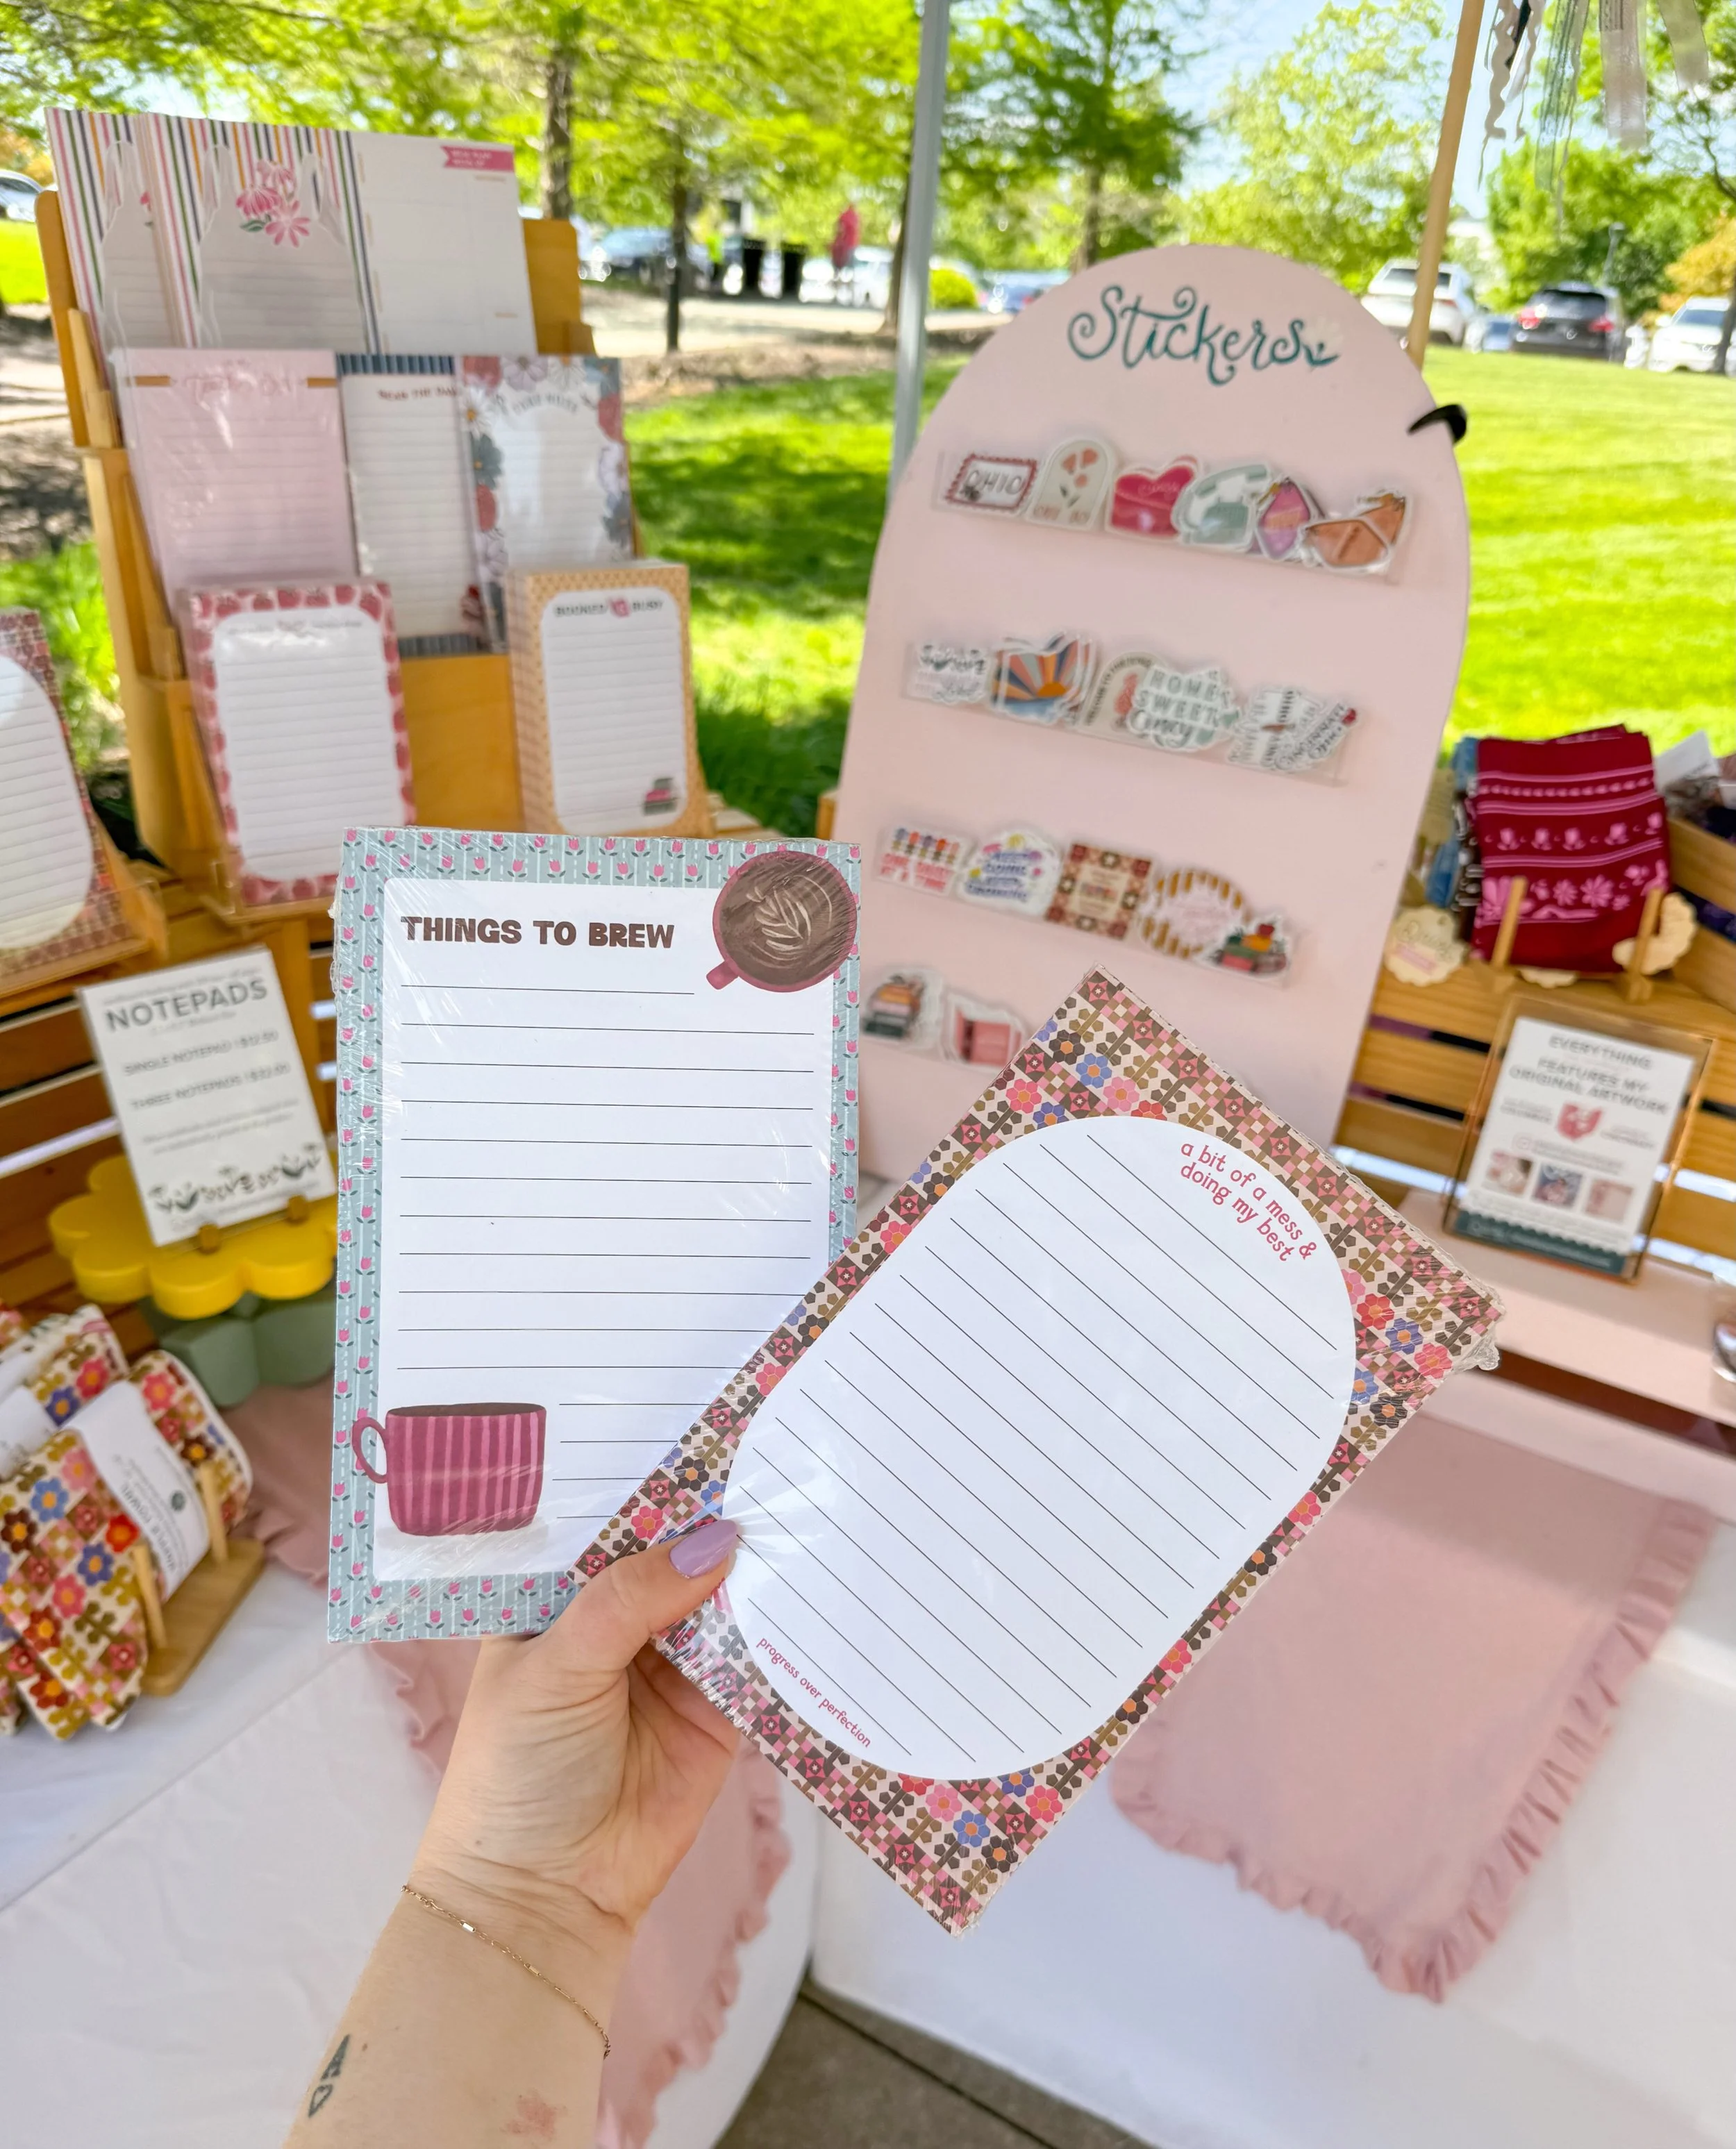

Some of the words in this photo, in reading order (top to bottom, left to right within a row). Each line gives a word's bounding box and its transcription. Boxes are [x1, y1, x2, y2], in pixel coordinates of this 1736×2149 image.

[1067, 285, 1303, 385] Stickers
[965, 469, 1022, 495] OHIO
[1151, 669, 1218, 701] HOME
[1135, 689, 1219, 725] SWEET
[401, 916, 521, 944] THINGS
[533, 920, 576, 946] TO
[589, 922, 674, 948] BREW
[106, 978, 267, 1032] NOTEPADS
[174, 1040, 232, 1064] NOTEPAD
[1549, 1033, 1653, 1070] EVERYTHING
[1509, 1064, 1584, 1096] ORIGINAL
[1587, 1086, 1669, 1115] ARTWORK
[1537, 1056, 1619, 1087] FEATURES
[1622, 1078, 1649, 1092] MY
[1180, 1143, 1194, 1157] a
[1198, 1144, 1226, 1172] bit
[1230, 1169, 1256, 1187] of
[1252, 1187, 1267, 1201] a
[1265, 1200, 1303, 1240] mess
[1299, 1241, 1317, 1260] &
[1180, 1162, 1232, 1205] doing
[1232, 1198, 1259, 1223] my
[1257, 1217, 1294, 1261] best
[756, 1638, 800, 1678] progress
[800, 1678, 821, 1698] over
[819, 1698, 871, 1748] perfection
